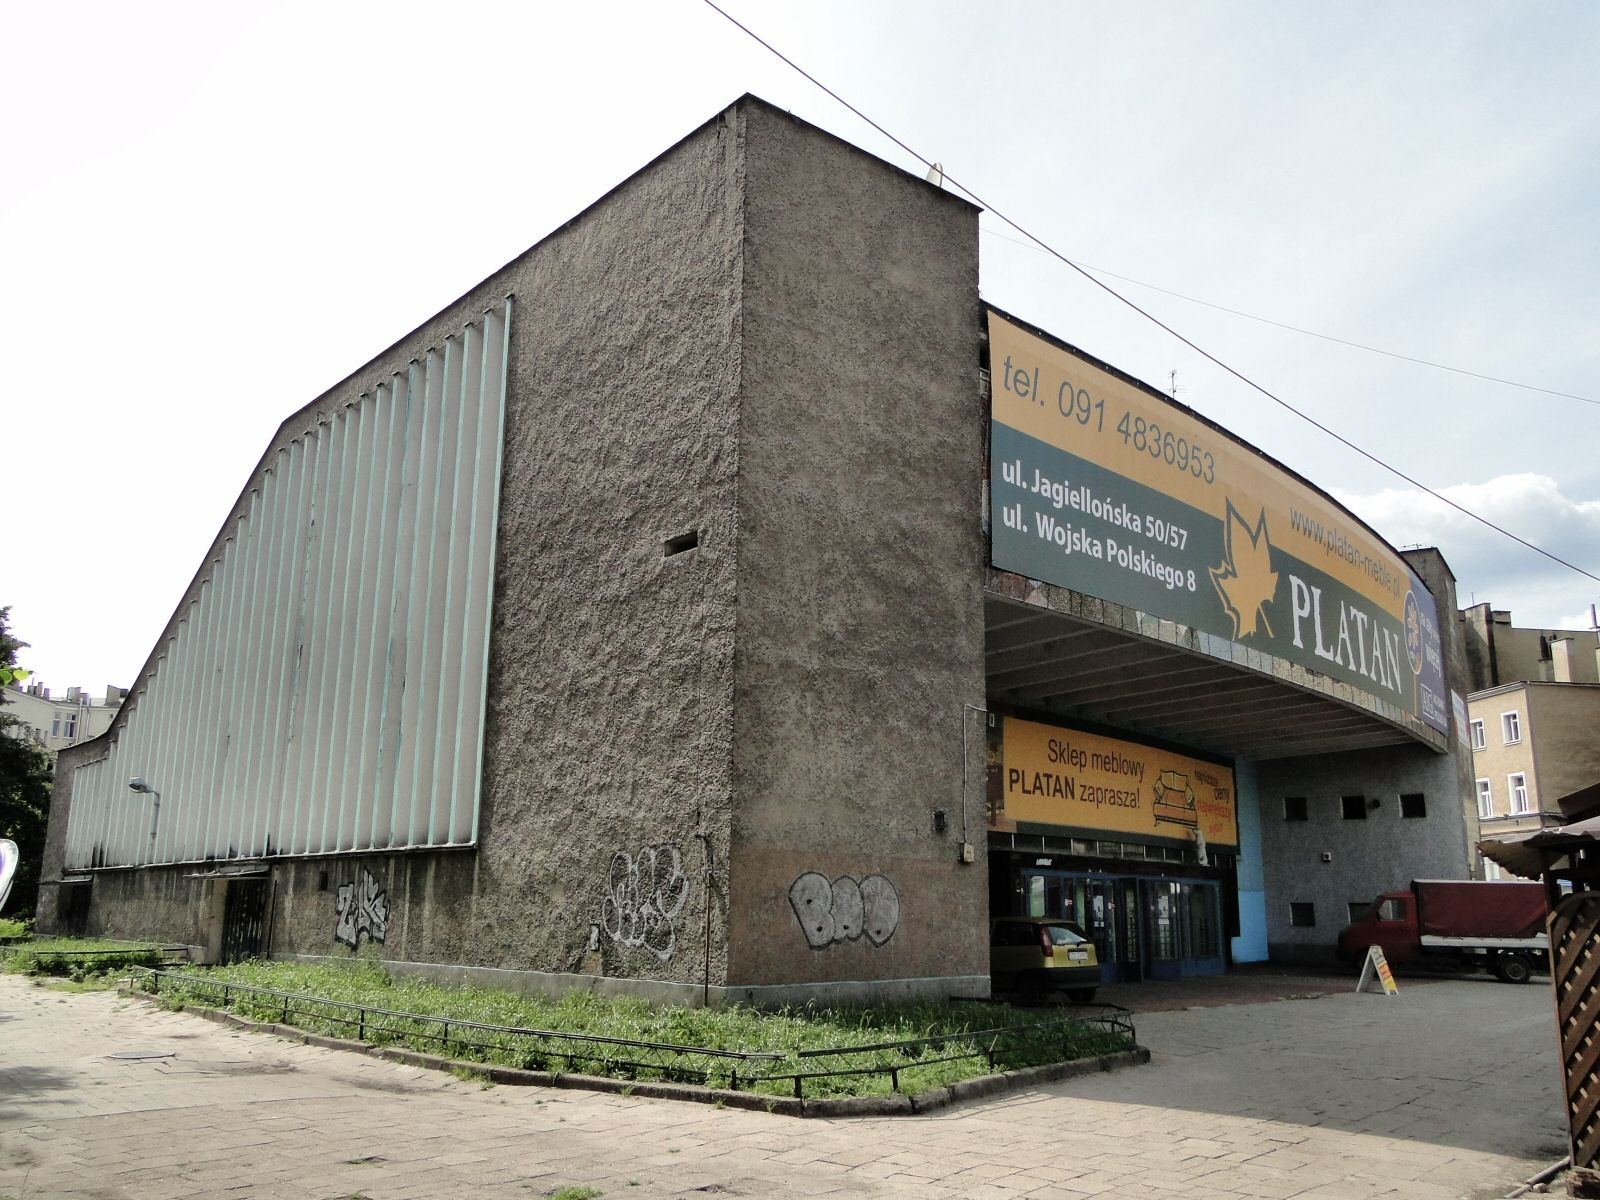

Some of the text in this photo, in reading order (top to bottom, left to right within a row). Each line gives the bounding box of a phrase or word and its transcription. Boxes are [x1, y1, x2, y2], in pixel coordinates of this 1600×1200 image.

[1003, 355, 1215, 485] tel. 091 4836953
[1002, 459, 1188, 551] ul. Jagiellońska 50/57
[1002, 503, 1197, 592] ul. Wojska Polskiego 8
[1289, 507, 1401, 601] www.platan-meble.pl
[1288, 574, 1402, 695] PLATAN
[1009, 768, 1141, 810] PLATAN zaprasza!
[1047, 739, 1145, 784] Sklep meblowy
